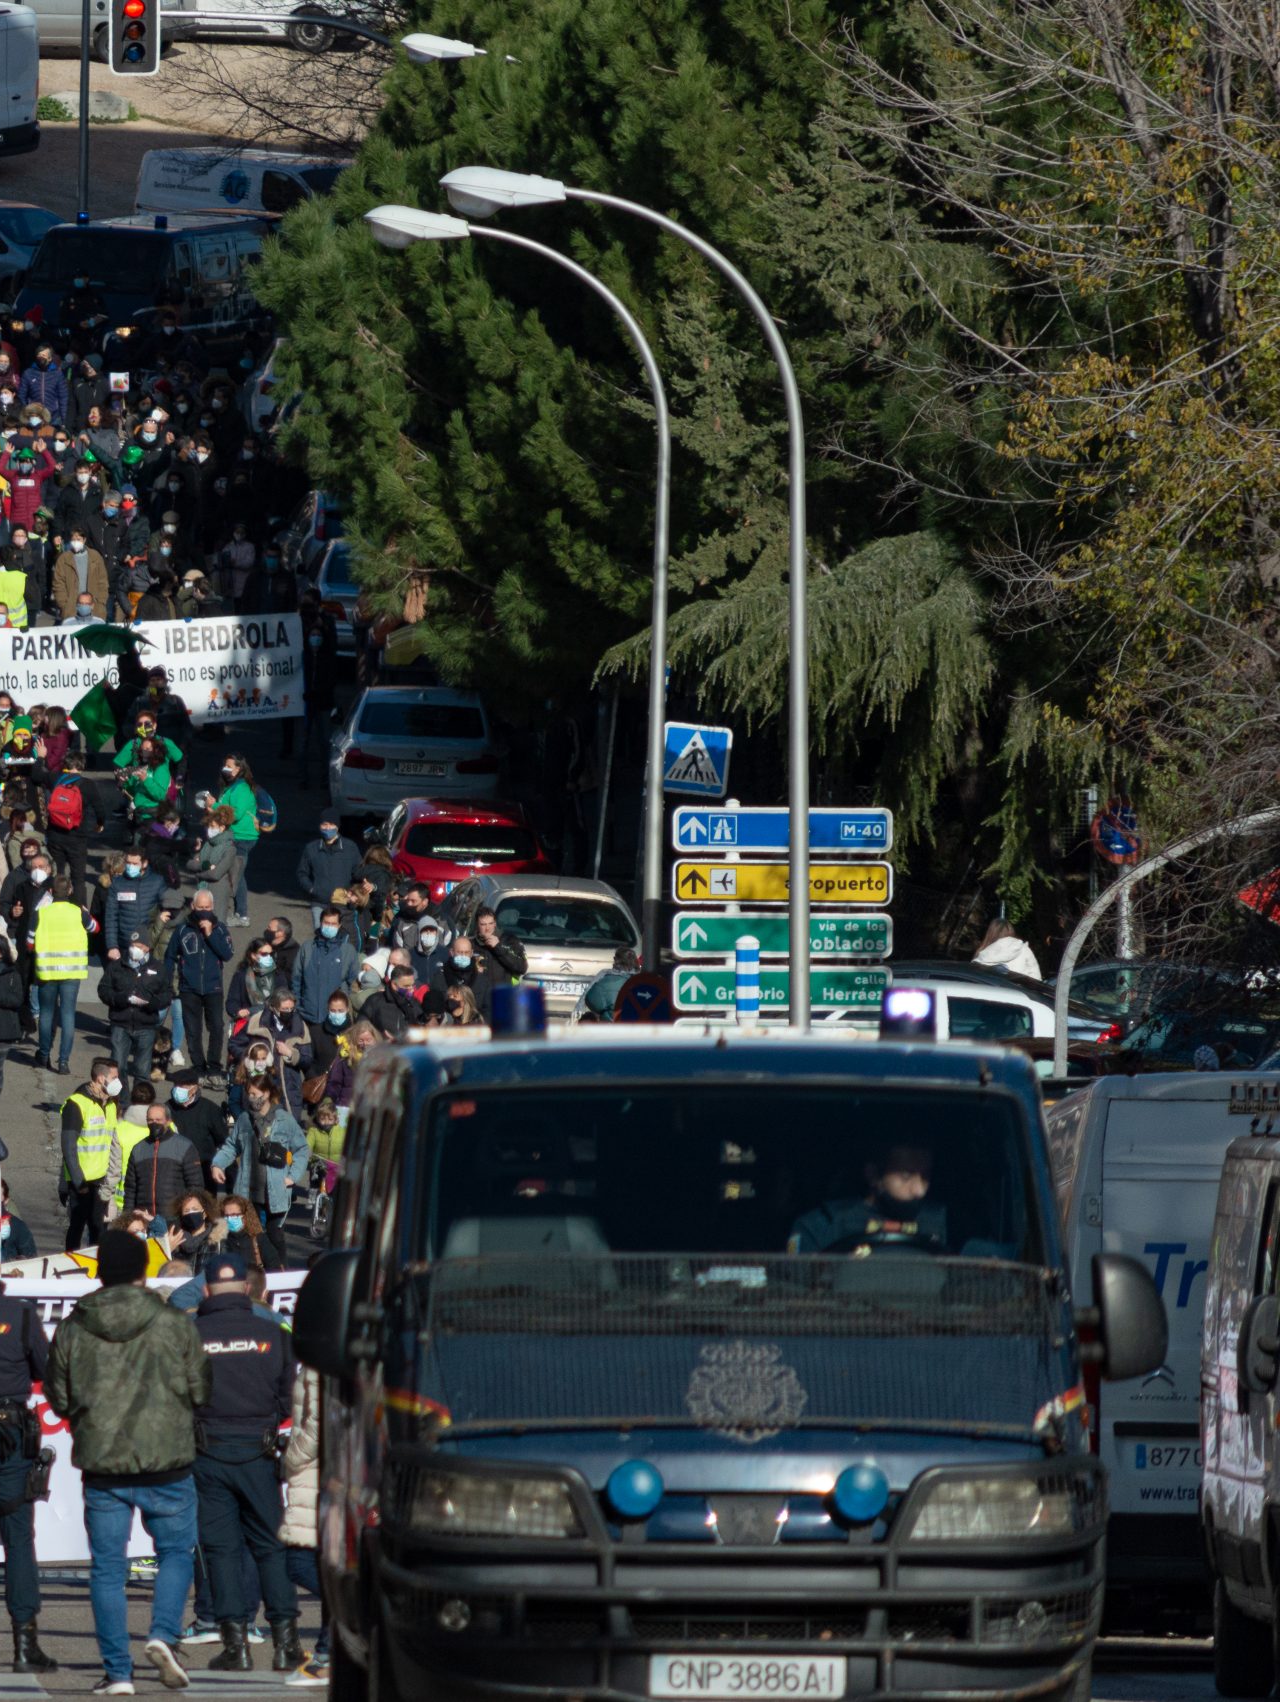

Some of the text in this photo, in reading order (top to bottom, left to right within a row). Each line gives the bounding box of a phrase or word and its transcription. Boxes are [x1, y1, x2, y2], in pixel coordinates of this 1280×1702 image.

[12, 634, 91, 661] PARKIN
[165, 621, 291, 654] IBERDROLA
[27, 670, 38, 689] la
[47, 669, 79, 688] salud
[83, 669, 98, 687] de
[180, 667, 196, 682] no
[200, 665, 215, 681] es
[220, 656, 294, 684] provisional
[843, 825, 883, 837] M-40
[785, 877, 885, 893] aropuerto
[844, 921, 859, 931] de
[867, 921, 885, 931] los
[809, 938, 885, 950] oblados
[855, 975, 885, 984] calle
[715, 987, 785, 1001] Grorio
